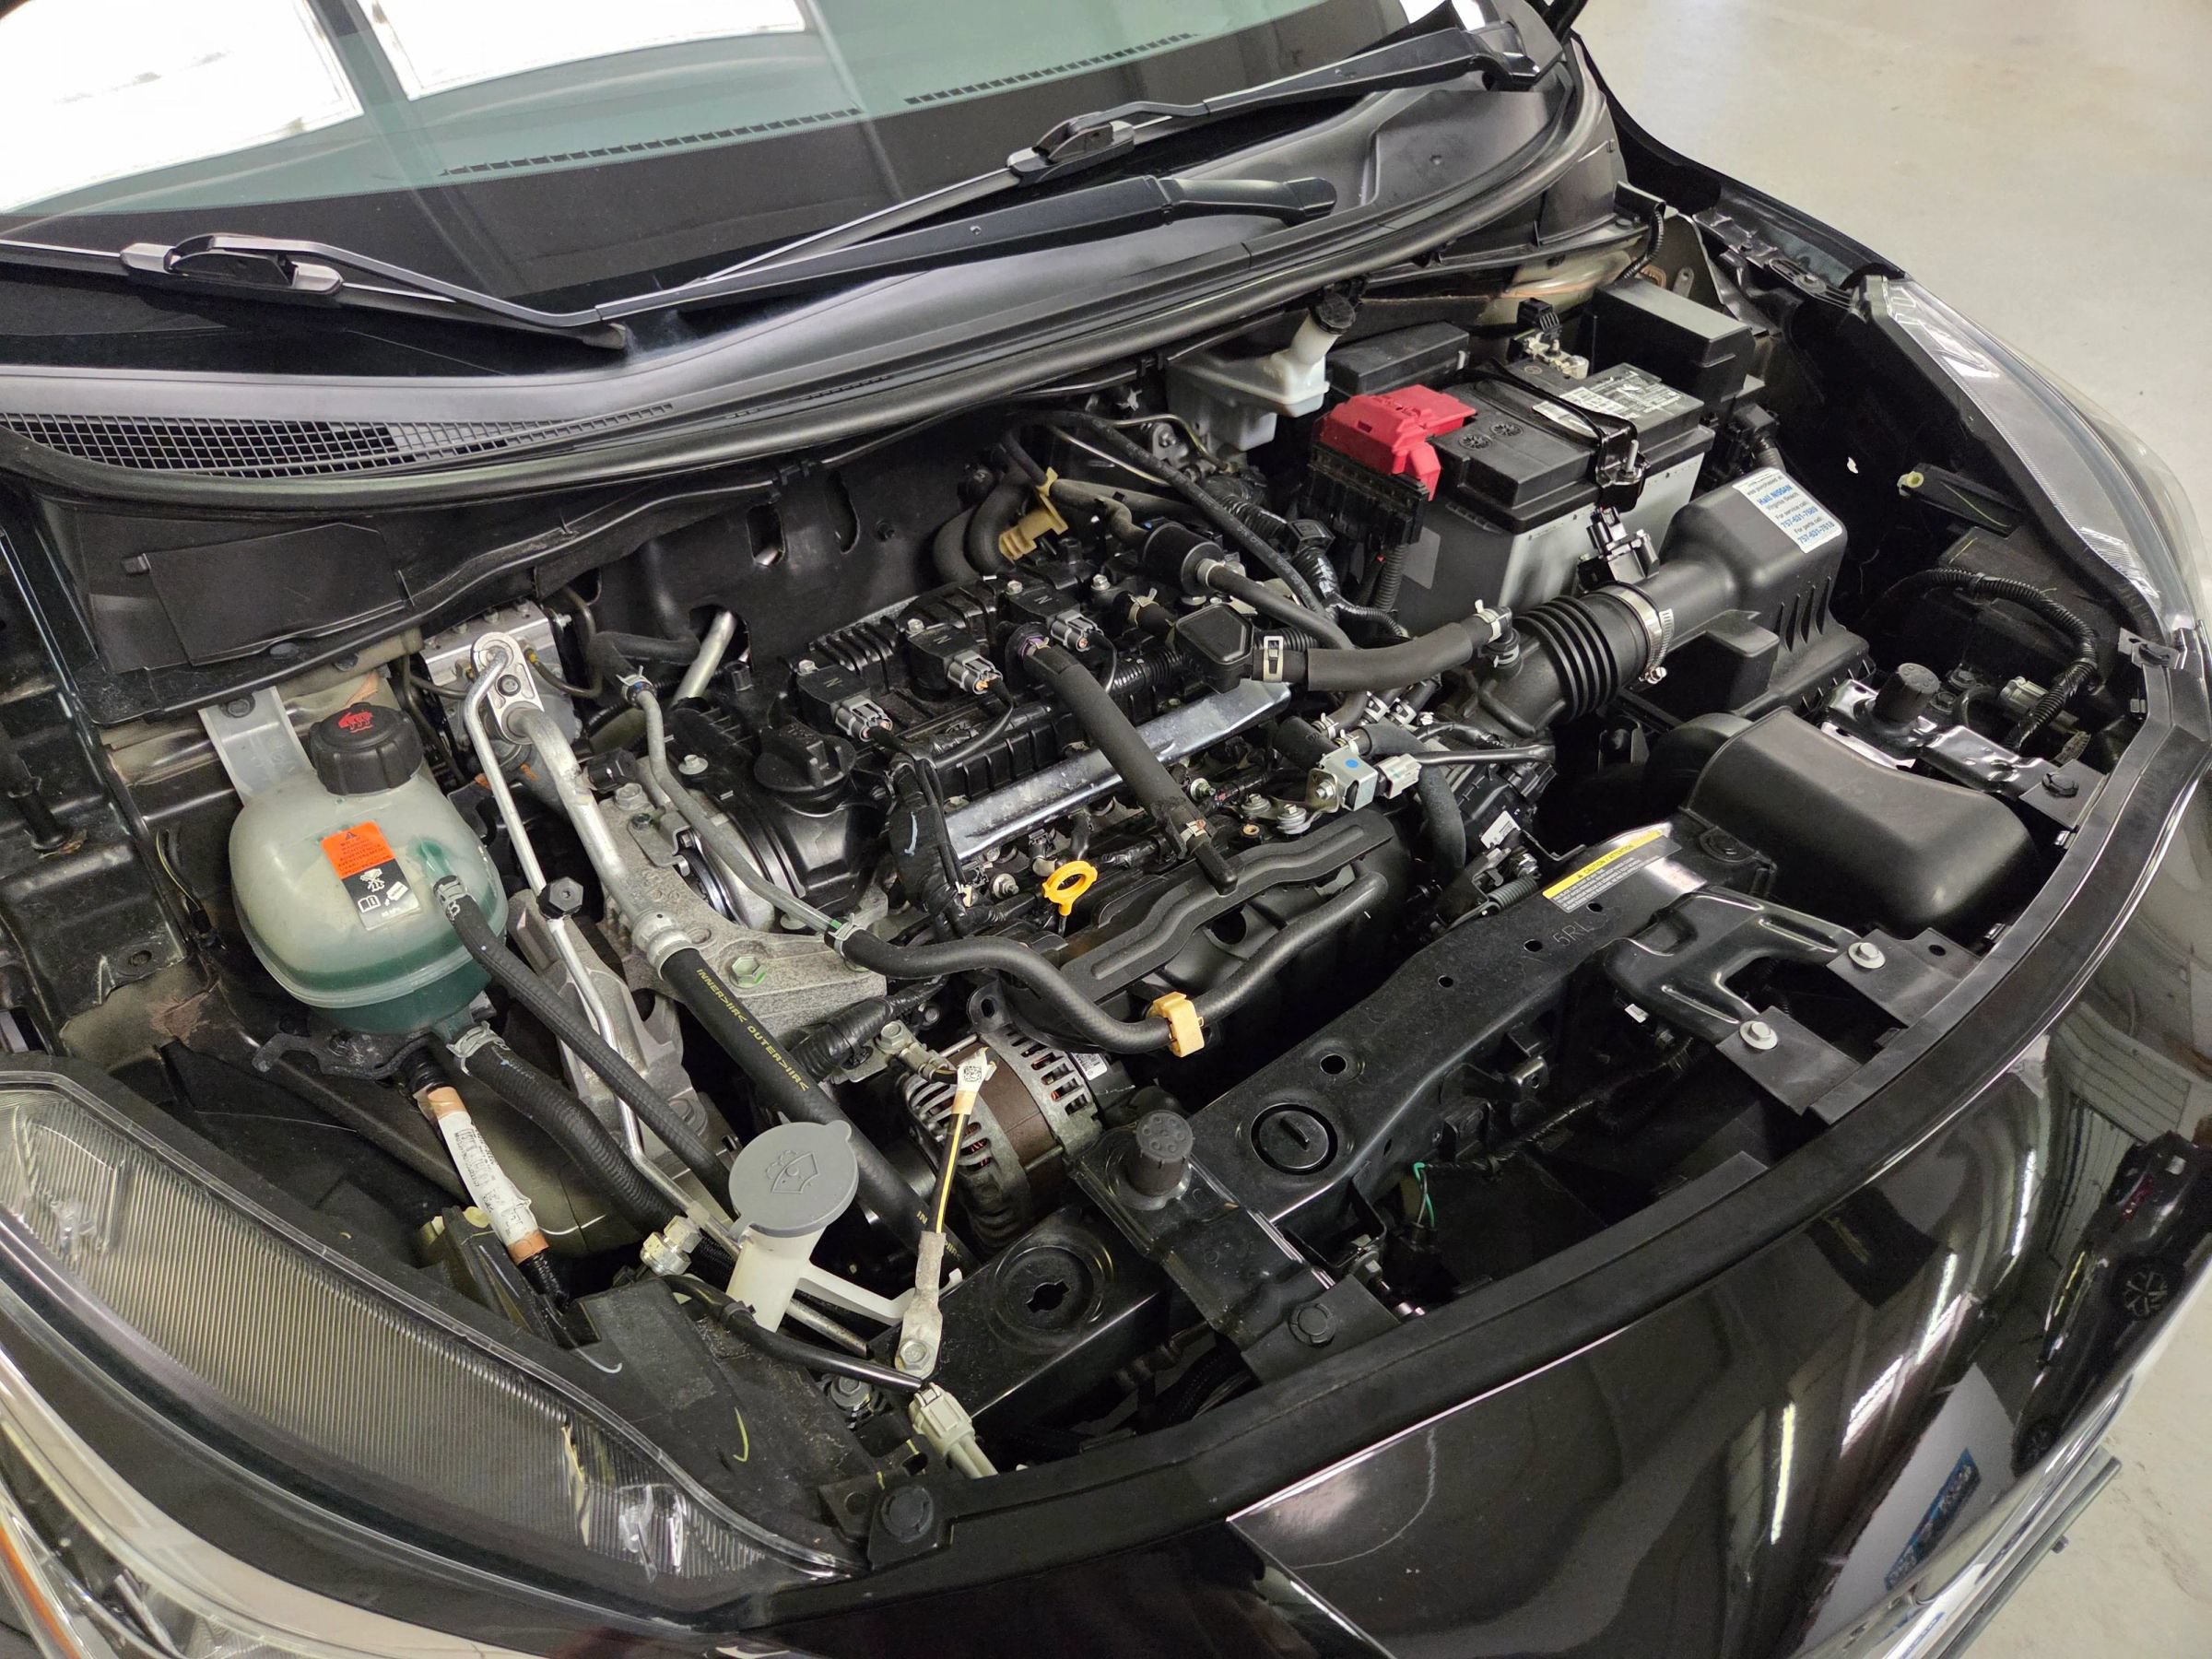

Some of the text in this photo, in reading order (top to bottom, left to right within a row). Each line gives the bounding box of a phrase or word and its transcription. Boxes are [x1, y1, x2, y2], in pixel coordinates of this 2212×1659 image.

[1771, 484, 1793, 499] NISSAN
[1583, 860, 1606, 874] CAUTION
[1609, 844, 1634, 859] ATTENTION
